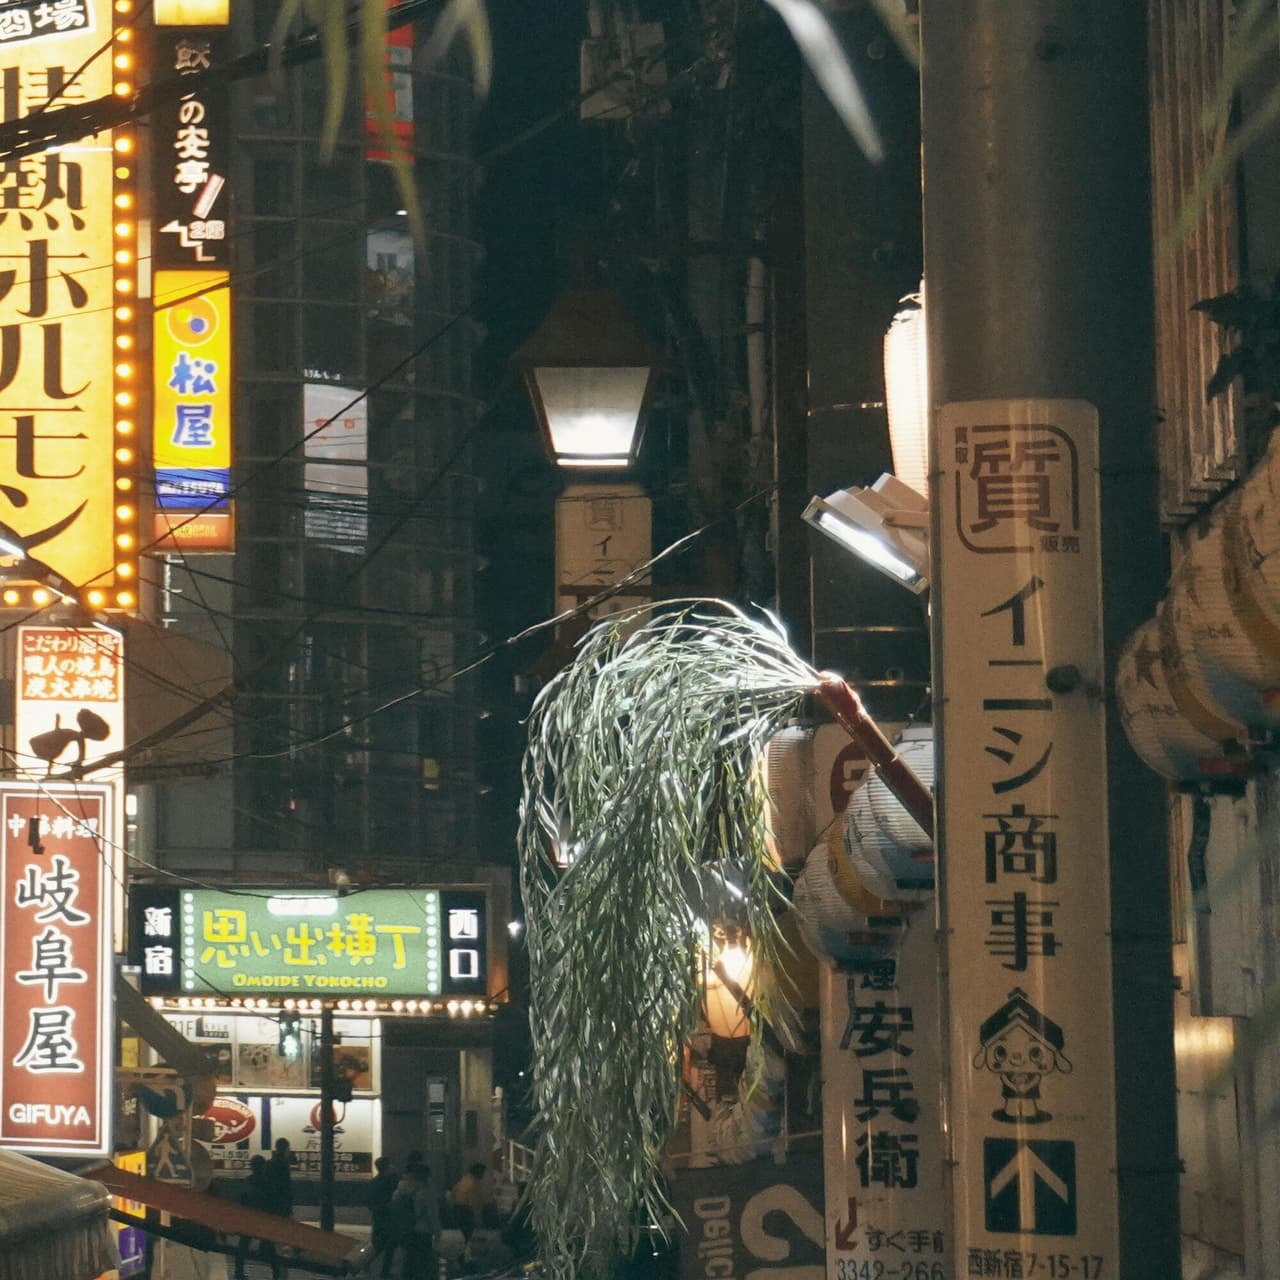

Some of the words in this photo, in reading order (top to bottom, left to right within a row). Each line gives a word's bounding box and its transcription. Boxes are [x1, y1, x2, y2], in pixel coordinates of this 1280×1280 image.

[168, 354, 217, 448] 松屋
[970, 440, 1061, 533] 質
[980, 575, 1063, 971] イニシ商事
[15, 853, 90, 1076] 岐阜屋
[144, 907, 173, 975] 新宿
[200, 909, 421, 969] 思い出横丁
[449, 909, 479, 978] 西口
[9, 1103, 91, 1126] GIFUYA
[853, 1000, 919, 1189] 安兵衛
